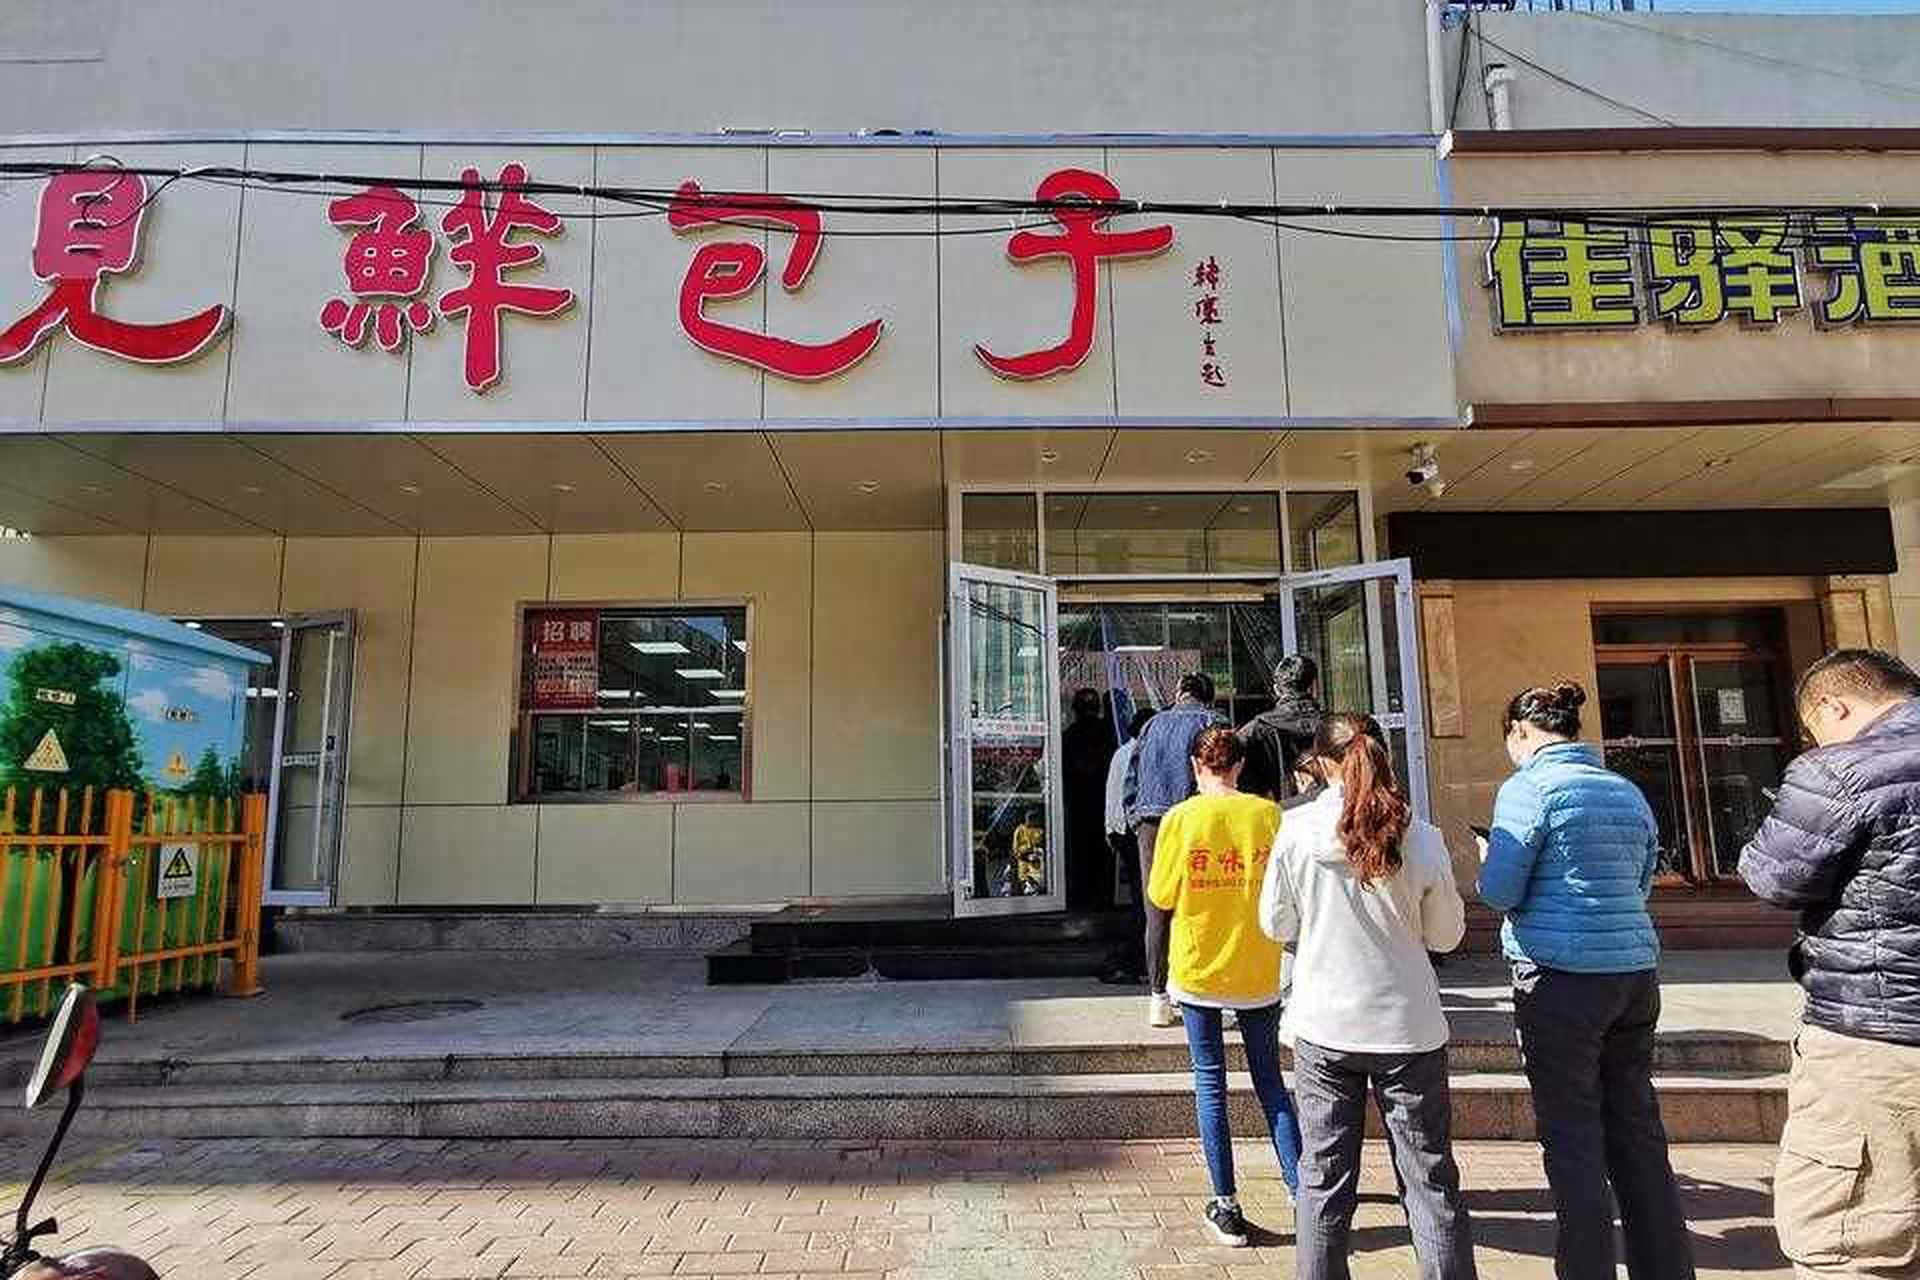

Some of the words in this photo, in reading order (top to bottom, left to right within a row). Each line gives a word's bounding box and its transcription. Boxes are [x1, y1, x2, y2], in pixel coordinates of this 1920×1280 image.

[1491, 214, 1920, 326] 佳驿酒
[543, 621, 593, 642] 招聘
